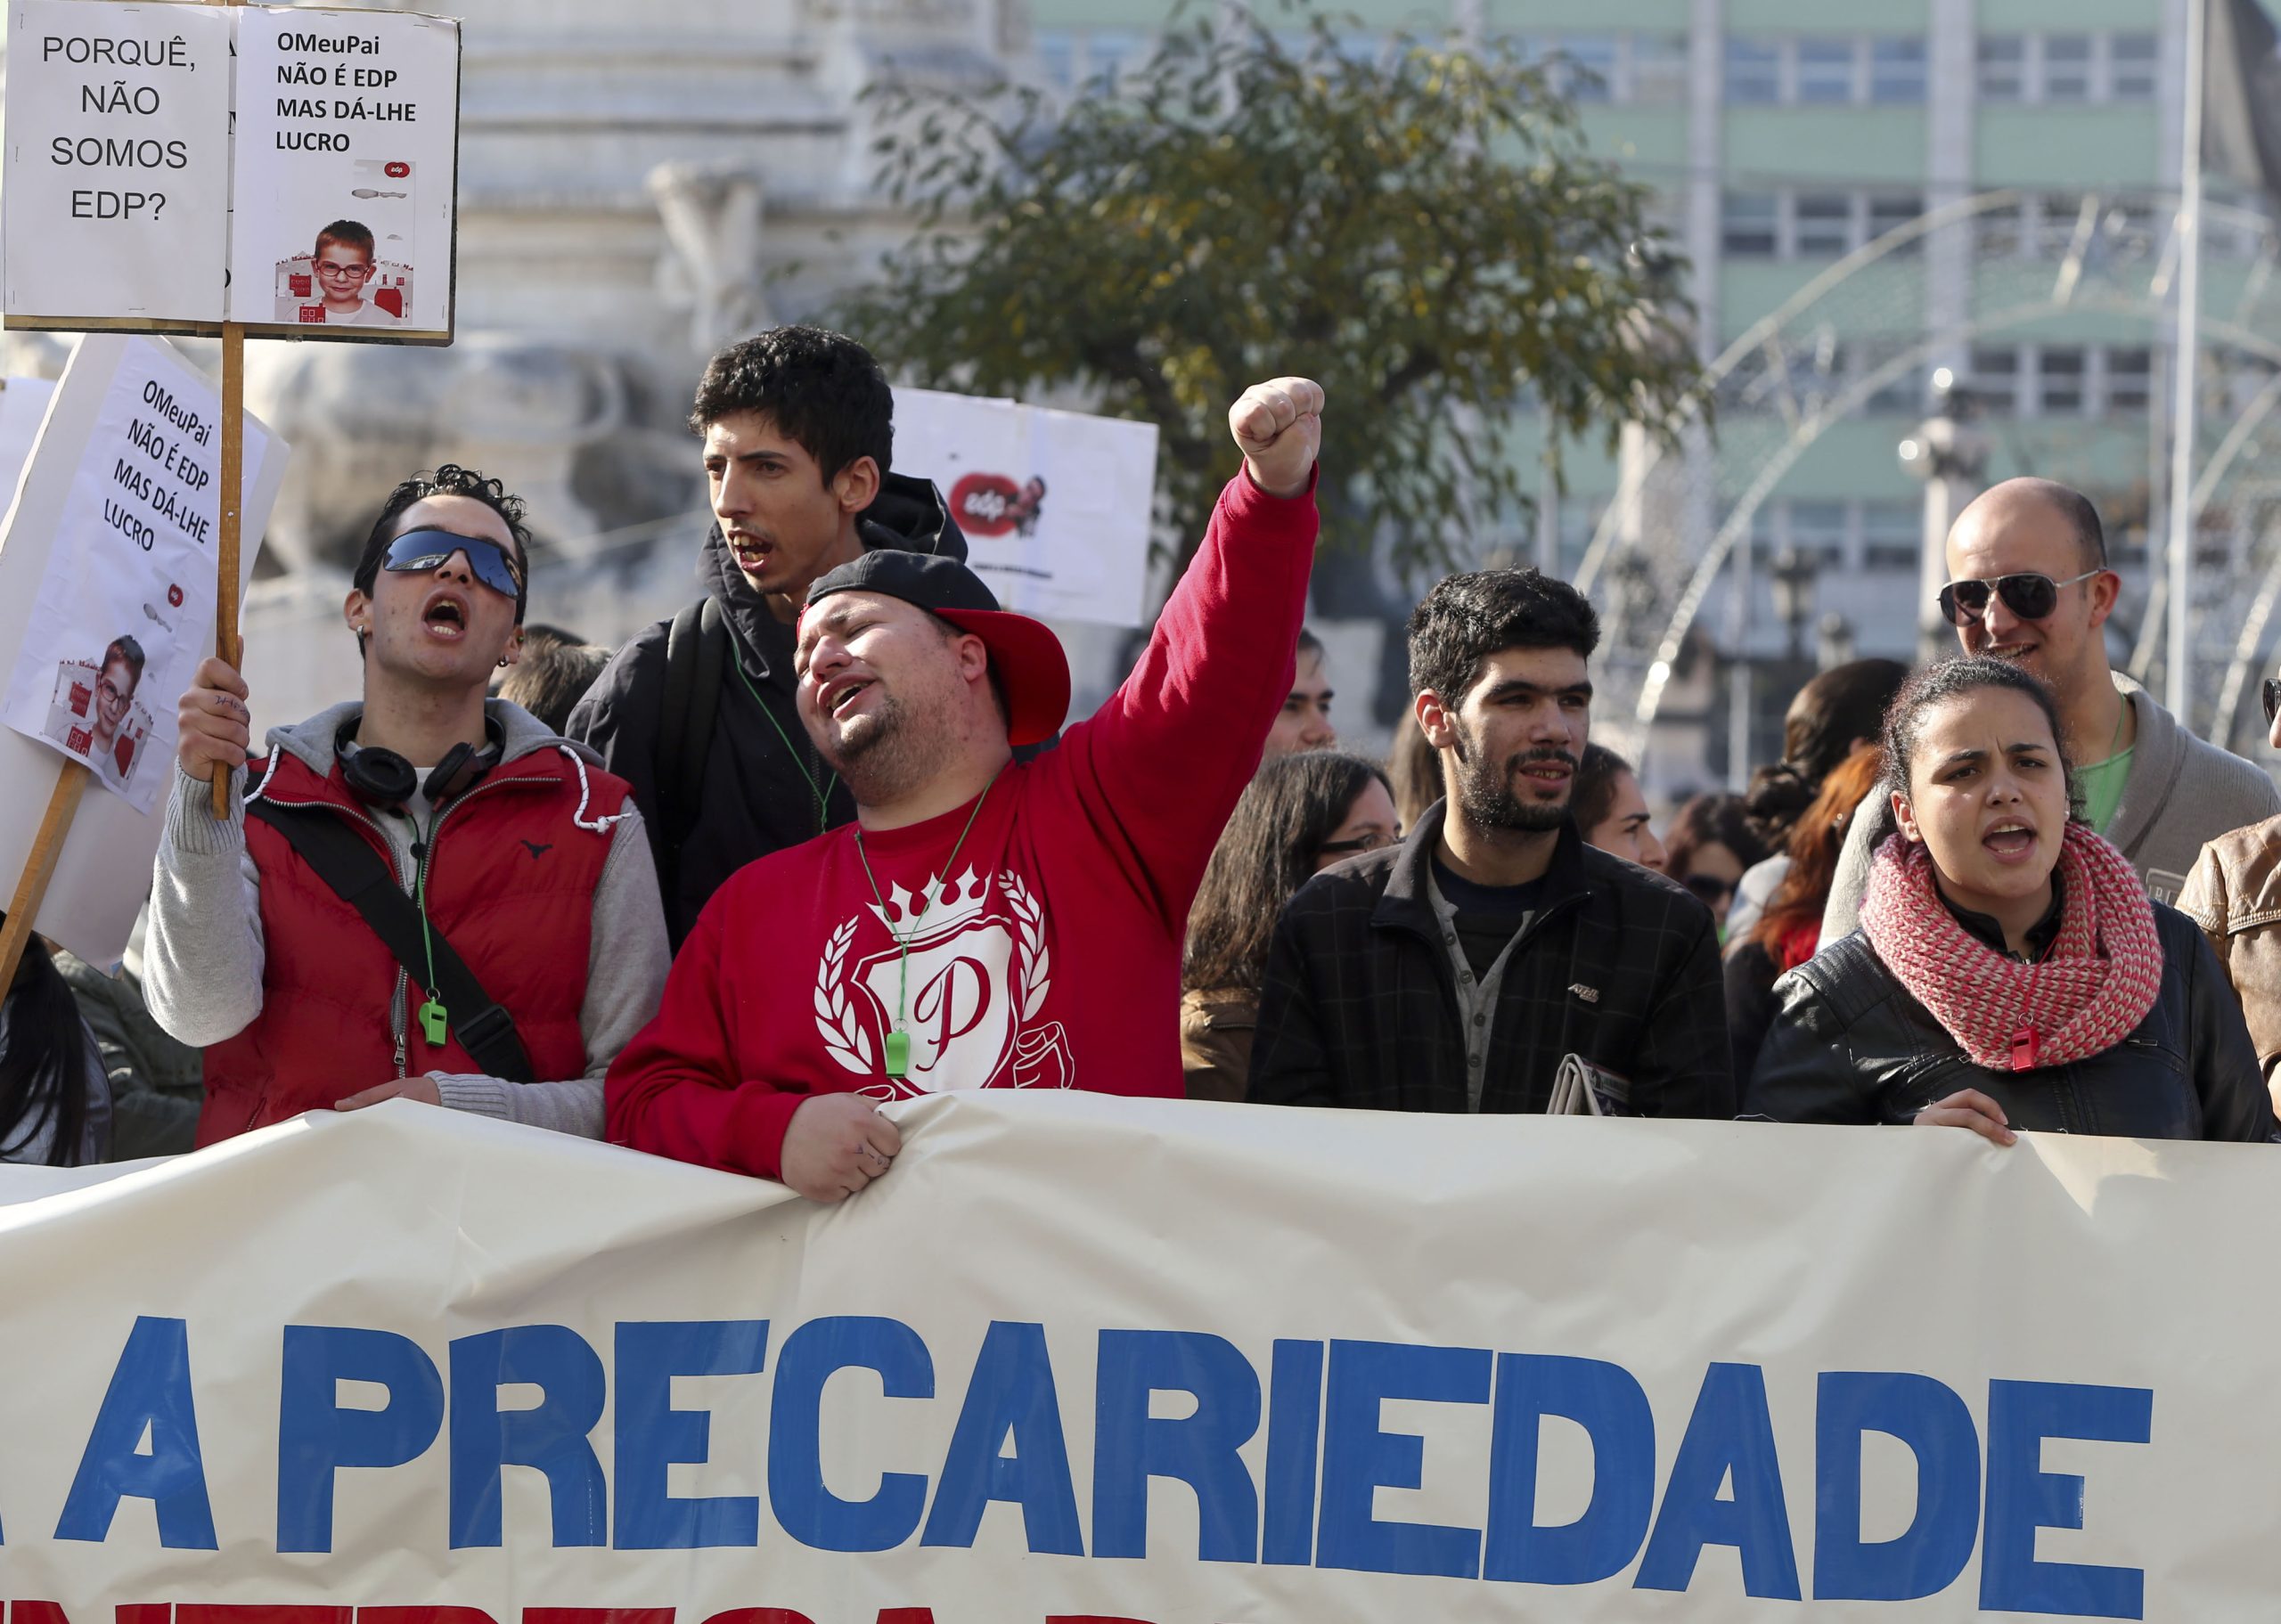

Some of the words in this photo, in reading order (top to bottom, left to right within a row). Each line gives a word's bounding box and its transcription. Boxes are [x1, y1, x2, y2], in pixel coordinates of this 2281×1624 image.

[44, 35, 195, 72] PORQUÊ,
[277, 32, 380, 55] OMeuPai
[277, 61, 327, 86] NÃO
[334, 62, 347, 86] É
[354, 69, 397, 88] EDP
[82, 80, 160, 115] NÃO
[276, 98, 327, 118] MAS
[334, 96, 416, 122] DÁ-LHE
[51, 136, 188, 169] SOMOS
[276, 131, 350, 152] LUCRO
[71, 190, 167, 221] EDP?
[143, 379, 212, 446] OMeuPai
[127, 418, 164, 461] NÃO
[164, 443, 180, 471] É
[176, 455, 209, 492] EDP
[113, 458, 151, 501] MAS
[151, 492, 209, 543] DÁ-LHE
[963, 489, 1006, 523] edp
[104, 498, 155, 551] LUCRO
[54, 1315, 218, 1550] A
[277, 1316, 2154, 1620] PRECARIEDADE
